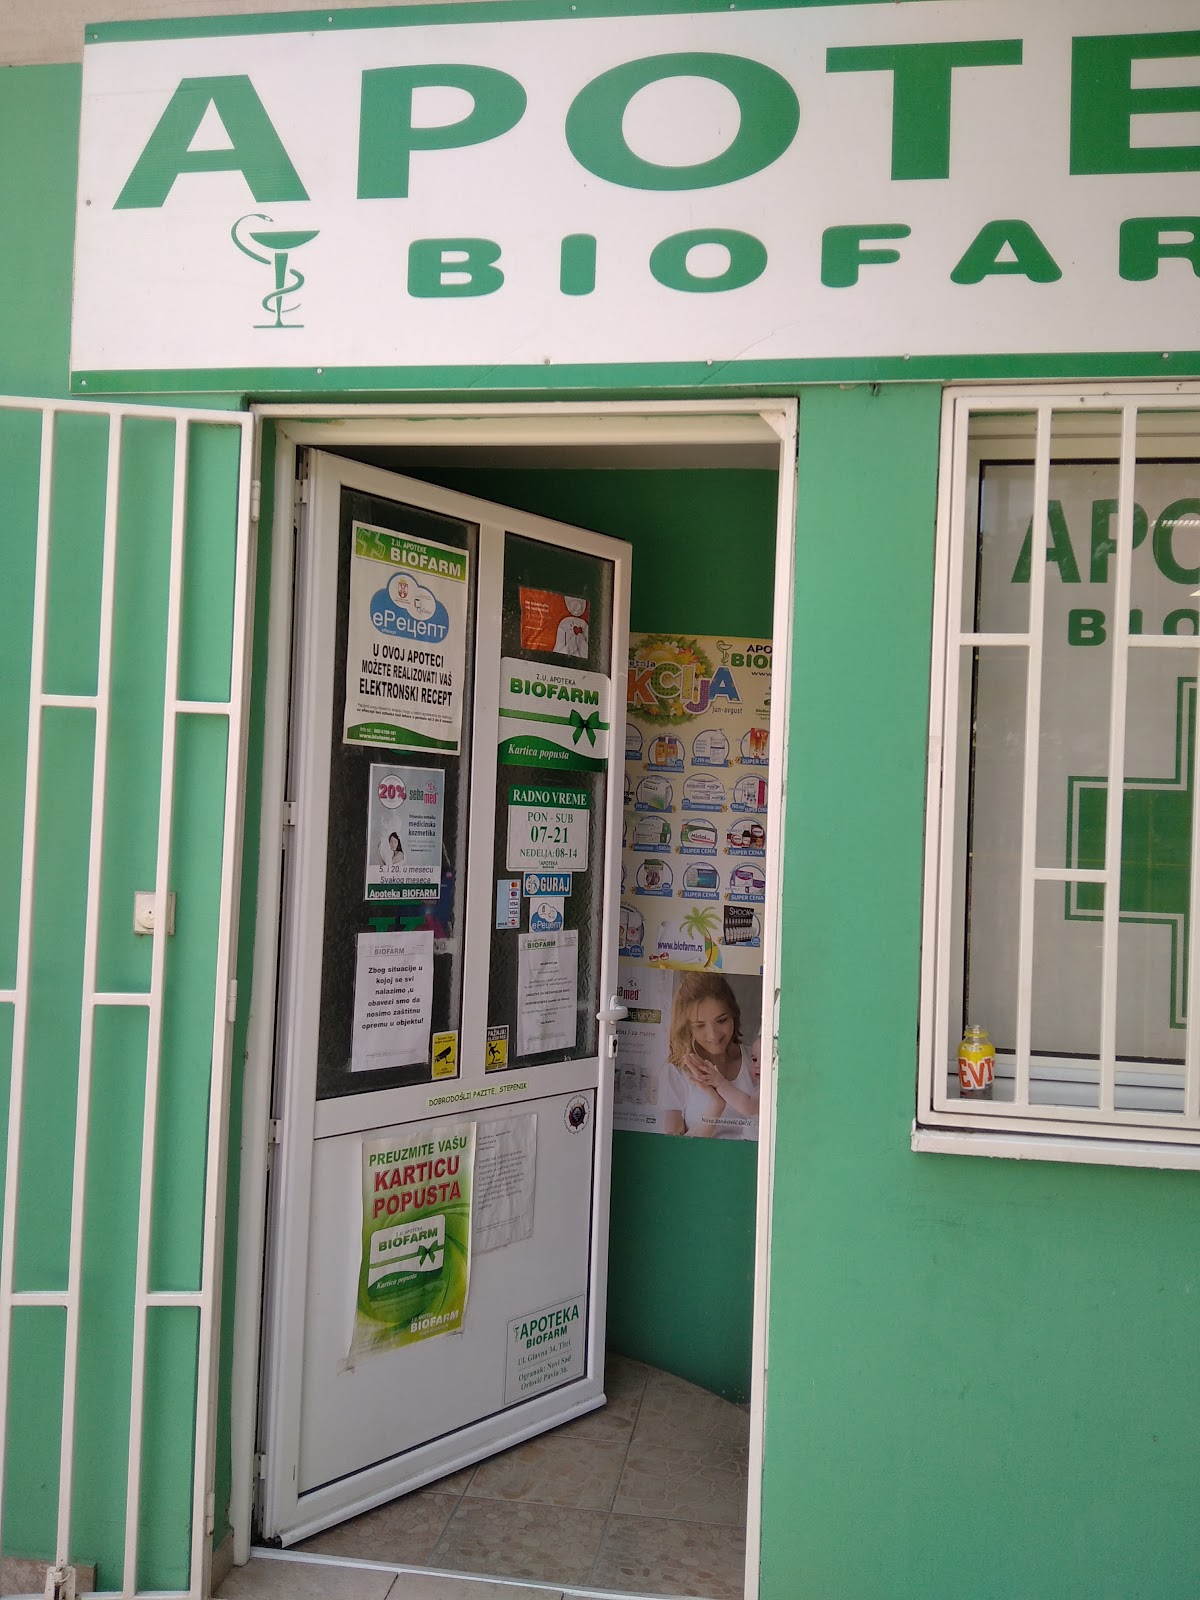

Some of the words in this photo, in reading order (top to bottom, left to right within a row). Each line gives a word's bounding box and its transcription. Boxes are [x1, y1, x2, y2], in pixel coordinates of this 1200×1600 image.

[112, 29, 1200, 210] APOTE
[407, 215, 1200, 298] BIOFAR
[402, 540, 428, 554] APOTEKE
[390, 547, 461, 577] BIOFARM
[373, 643, 380, 657] U
[382, 645, 405, 661] OVOJ
[407, 649, 444, 668] APOTECI
[731, 653, 772, 670] BIO
[361, 659, 392, 677] MOŽETE
[393, 665, 438, 685] REALIZOVATI
[439, 671, 453, 687] VAŠ
[550, 675, 576, 686] APOTEKA
[359, 678, 419, 702] ELEKTRONSKI
[421, 687, 453, 707] RECEPT
[510, 677, 599, 706] BIOFARM
[508, 743, 538, 757] Kartica
[539, 747, 570, 761] popusta
[378, 783, 407, 801] 20%
[513, 788, 550, 804] RADNO
[552, 792, 587, 806] VREME
[527, 811, 548, 823] PON
[555, 812, 574, 824] SUB
[530, 825, 568, 844] 07-21
[380, 876, 405, 885] Svakog
[540, 876, 570, 892] GURAJ
[369, 888, 401, 899] Apoteka
[402, 888, 437, 898] BIOFARM
[527, 940, 556, 949] BIOFARM
[368, 967, 386, 975] Zbog
[387, 965, 417, 973] situacije
[376, 977, 394, 985] kojoj
[375, 987, 406, 995] nalazimo
[367, 997, 394, 1007] obavezi
[366, 1010, 392, 1018] nosimo
[393, 1008, 421, 1016] zaštitnu
[361, 1021, 388, 1030] opremu
[396, 1017, 424, 1027] objektu!
[499, 1082, 528, 1093] STEPENIK
[369, 1142, 435, 1167] PREUZMITE
[438, 1135, 467, 1153] VAŠU
[374, 1155, 460, 1193] KARTICU
[373, 1180, 461, 1220] POPUSTA
[378, 1227, 438, 1252] BIOFARM
[410, 1309, 460, 1334] BIOFARM
[519, 1304, 579, 1341] APOTEKA
[526, 1325, 568, 1350] BIOFARM
[527, 1349, 548, 1363] Glavna
[518, 1366, 547, 1382] Ogranak:
